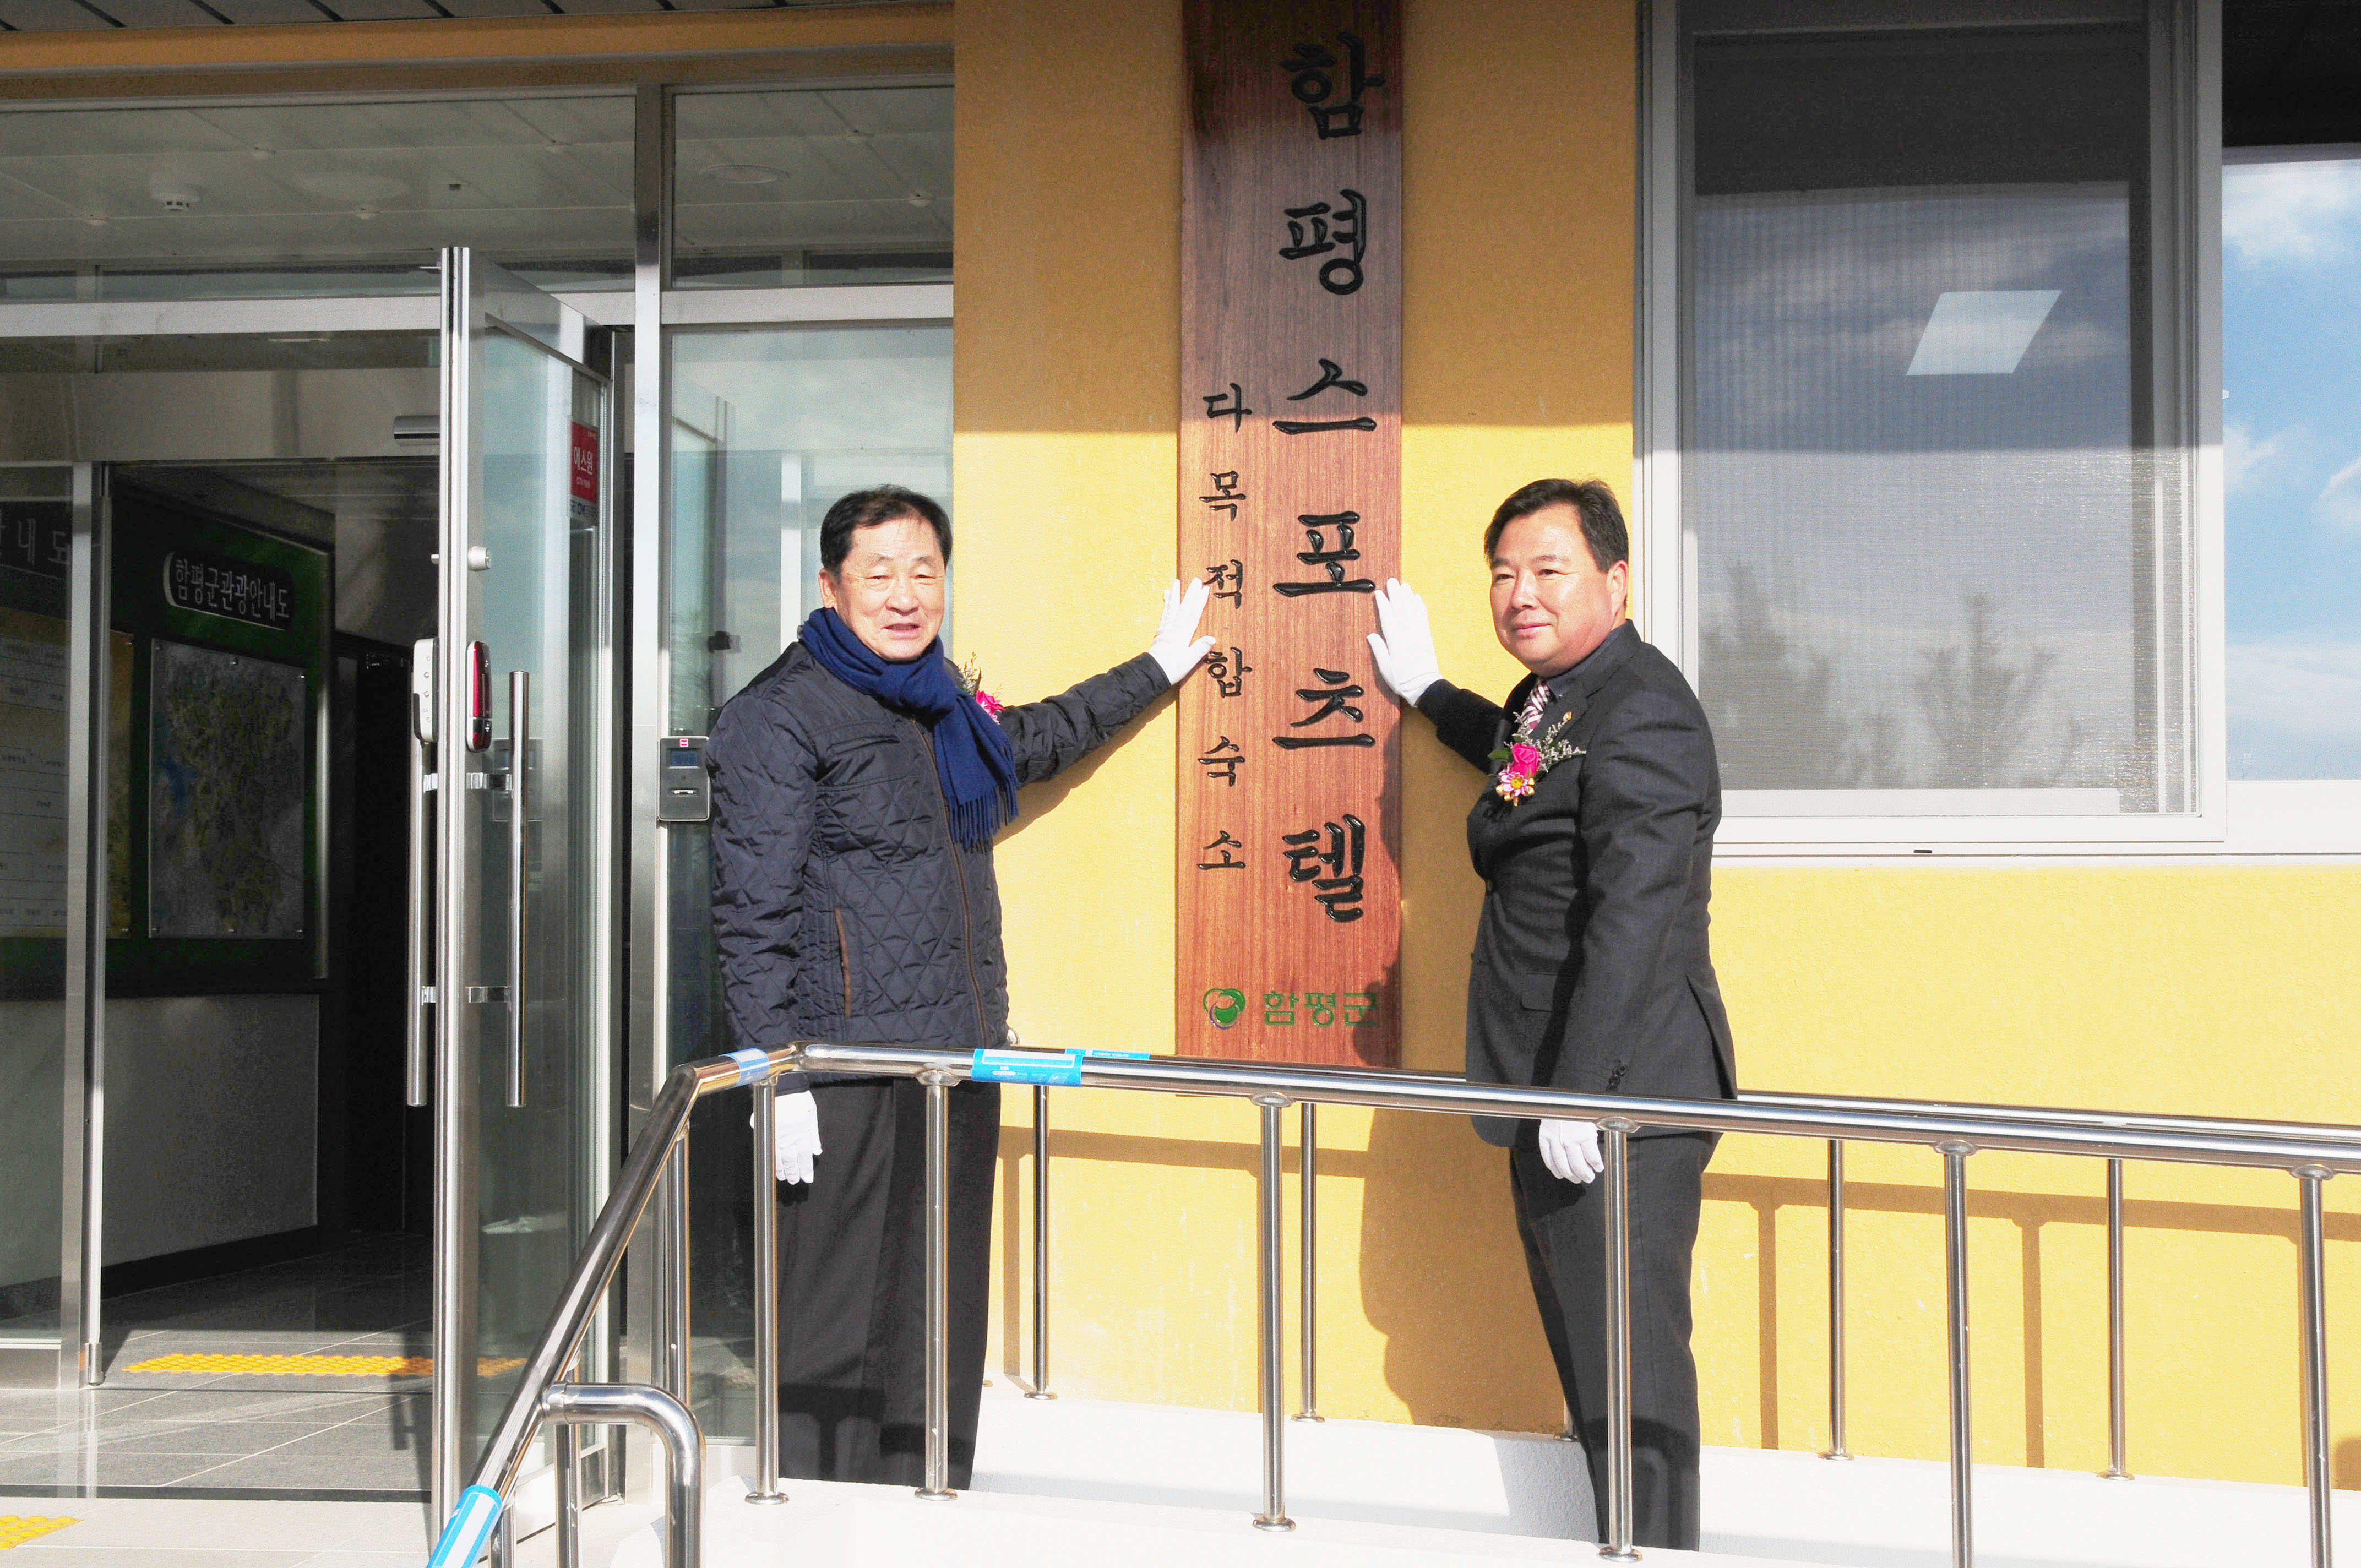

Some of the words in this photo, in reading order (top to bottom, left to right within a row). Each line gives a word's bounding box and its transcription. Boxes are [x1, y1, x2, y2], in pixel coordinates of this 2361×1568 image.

[574, 446, 593, 476] 에스원
[174, 558, 290, 622] 함평군관광안내도
[1262, 990, 1378, 1028] 함평군
